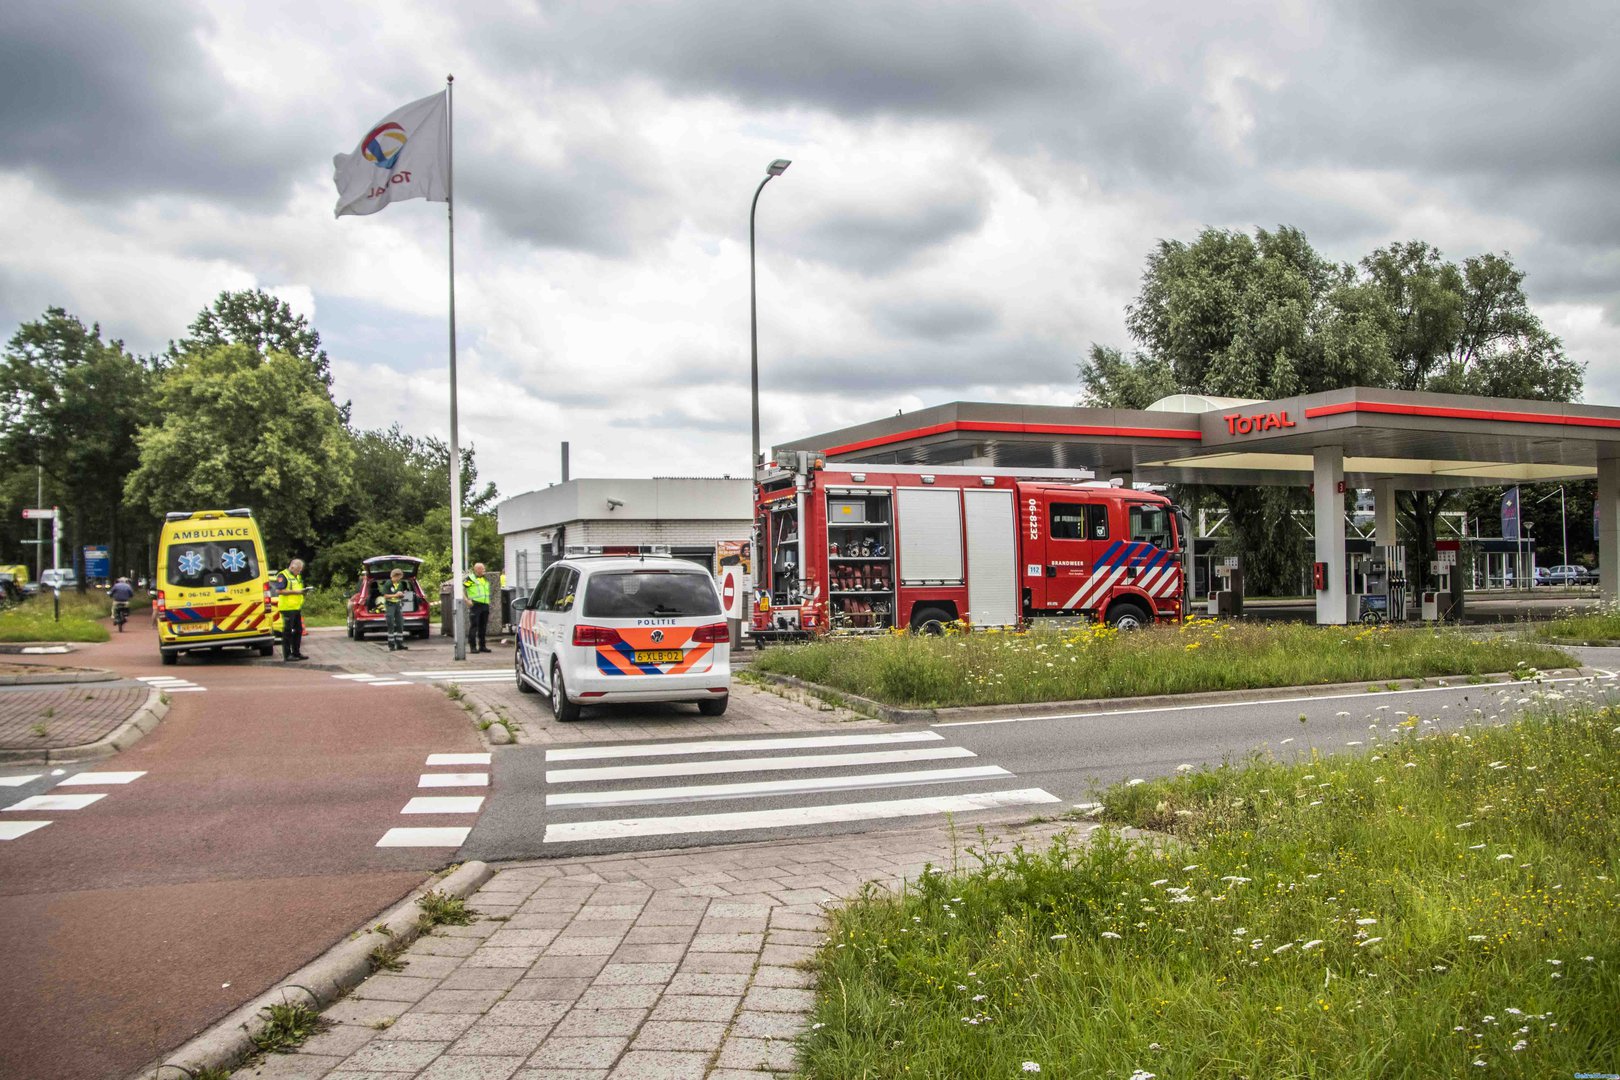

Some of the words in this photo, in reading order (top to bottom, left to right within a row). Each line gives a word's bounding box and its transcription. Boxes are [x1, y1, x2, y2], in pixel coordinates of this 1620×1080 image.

[1223, 410, 1296, 435] TOTAL
[1028, 498, 1038, 540] 06-8232
[173, 528, 249, 540] AMBULANCE
[637, 651, 679, 661] 6-XLB-02
